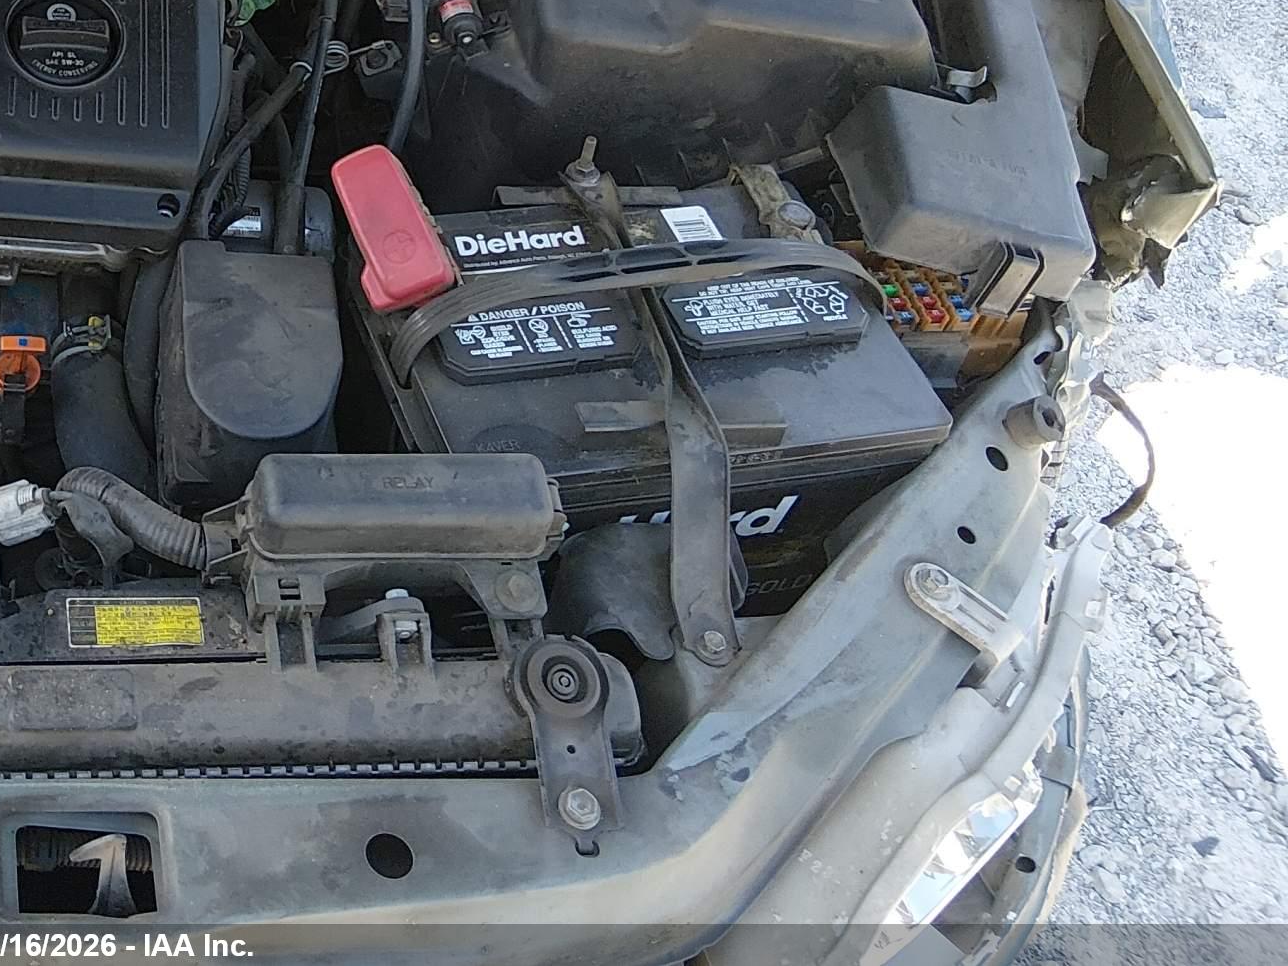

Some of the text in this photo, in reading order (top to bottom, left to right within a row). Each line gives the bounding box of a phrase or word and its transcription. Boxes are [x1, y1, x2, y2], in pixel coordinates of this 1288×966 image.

[454, 225, 586, 257] DieHard
[480, 308, 530, 322] DANGER
[540, 301, 586, 315] POISON
[383, 475, 434, 490] RELAY
